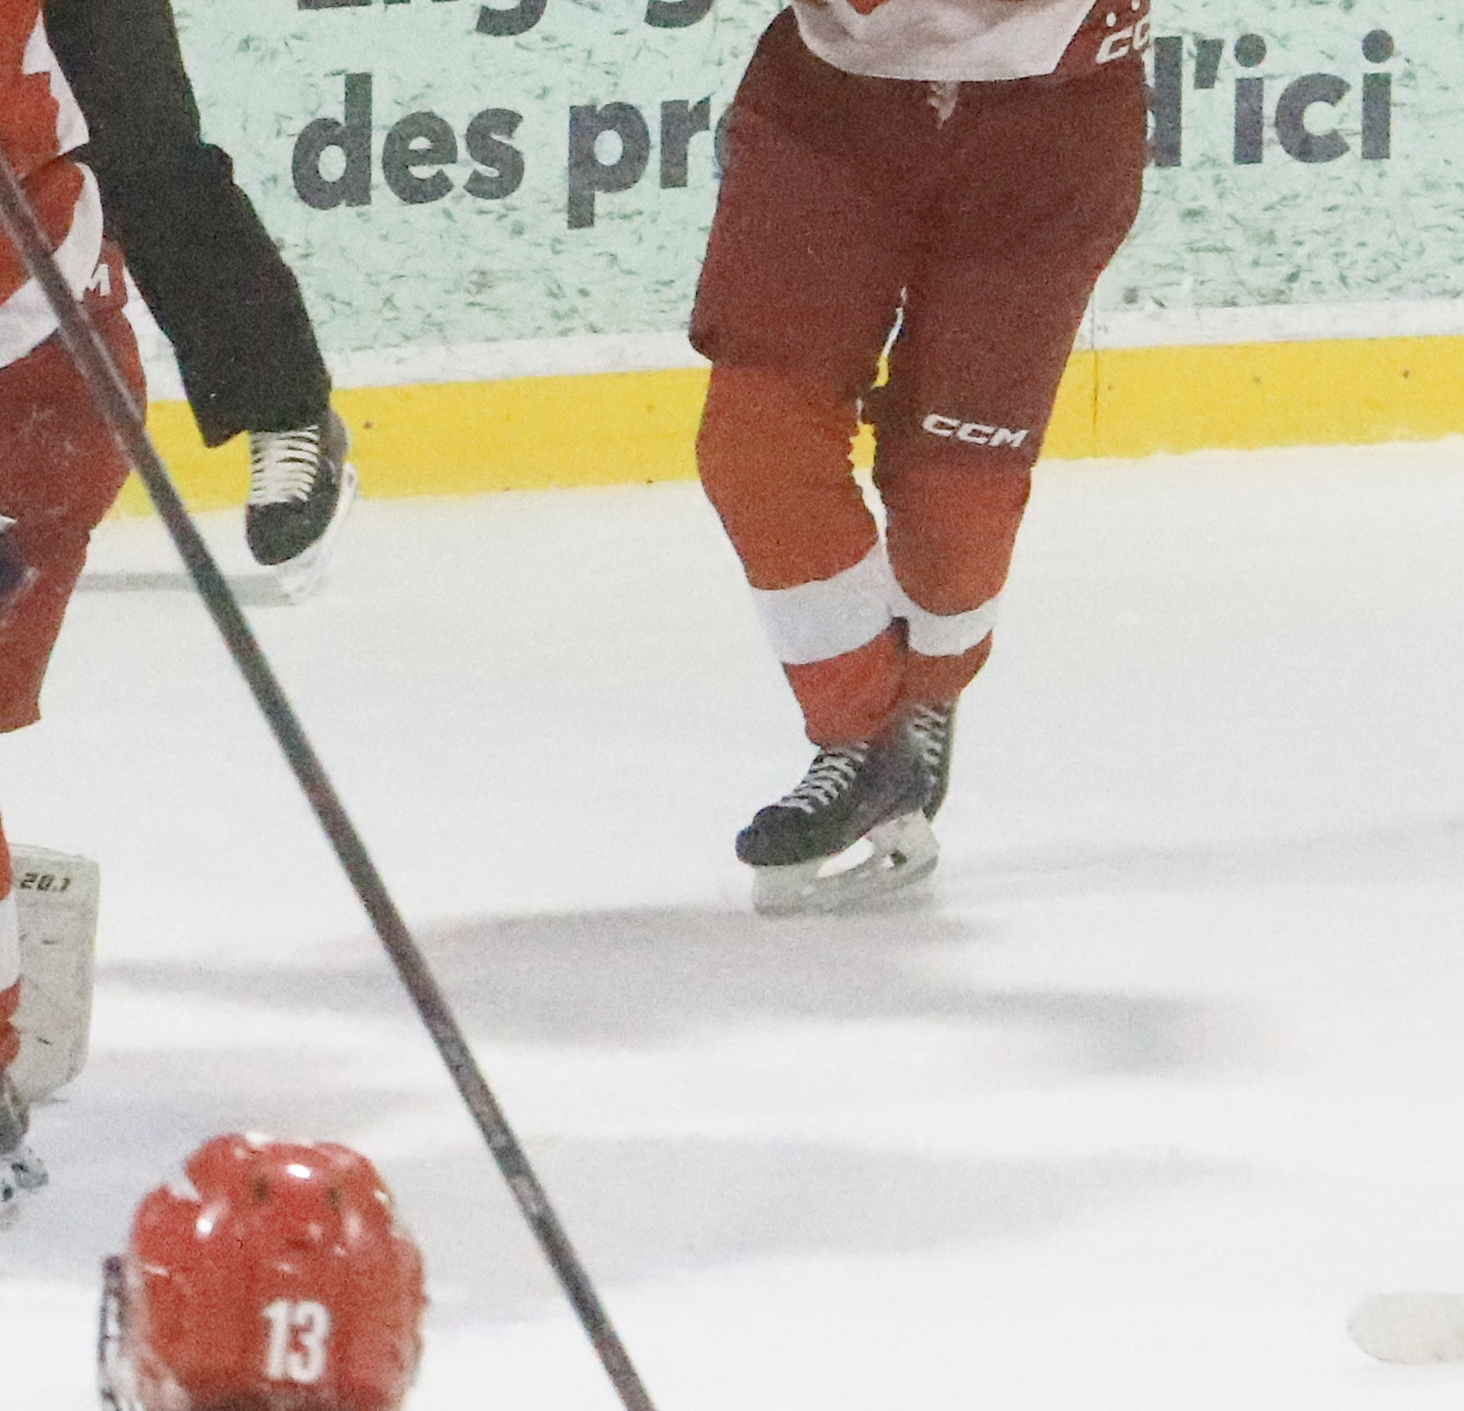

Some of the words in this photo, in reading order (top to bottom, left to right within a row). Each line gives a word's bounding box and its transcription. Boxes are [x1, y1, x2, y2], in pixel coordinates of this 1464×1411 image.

[291, 72, 526, 210] des
[566, 93, 734, 229] pr
[921, 411, 1029, 450] CCM
[262, 1299, 331, 1382] 13
